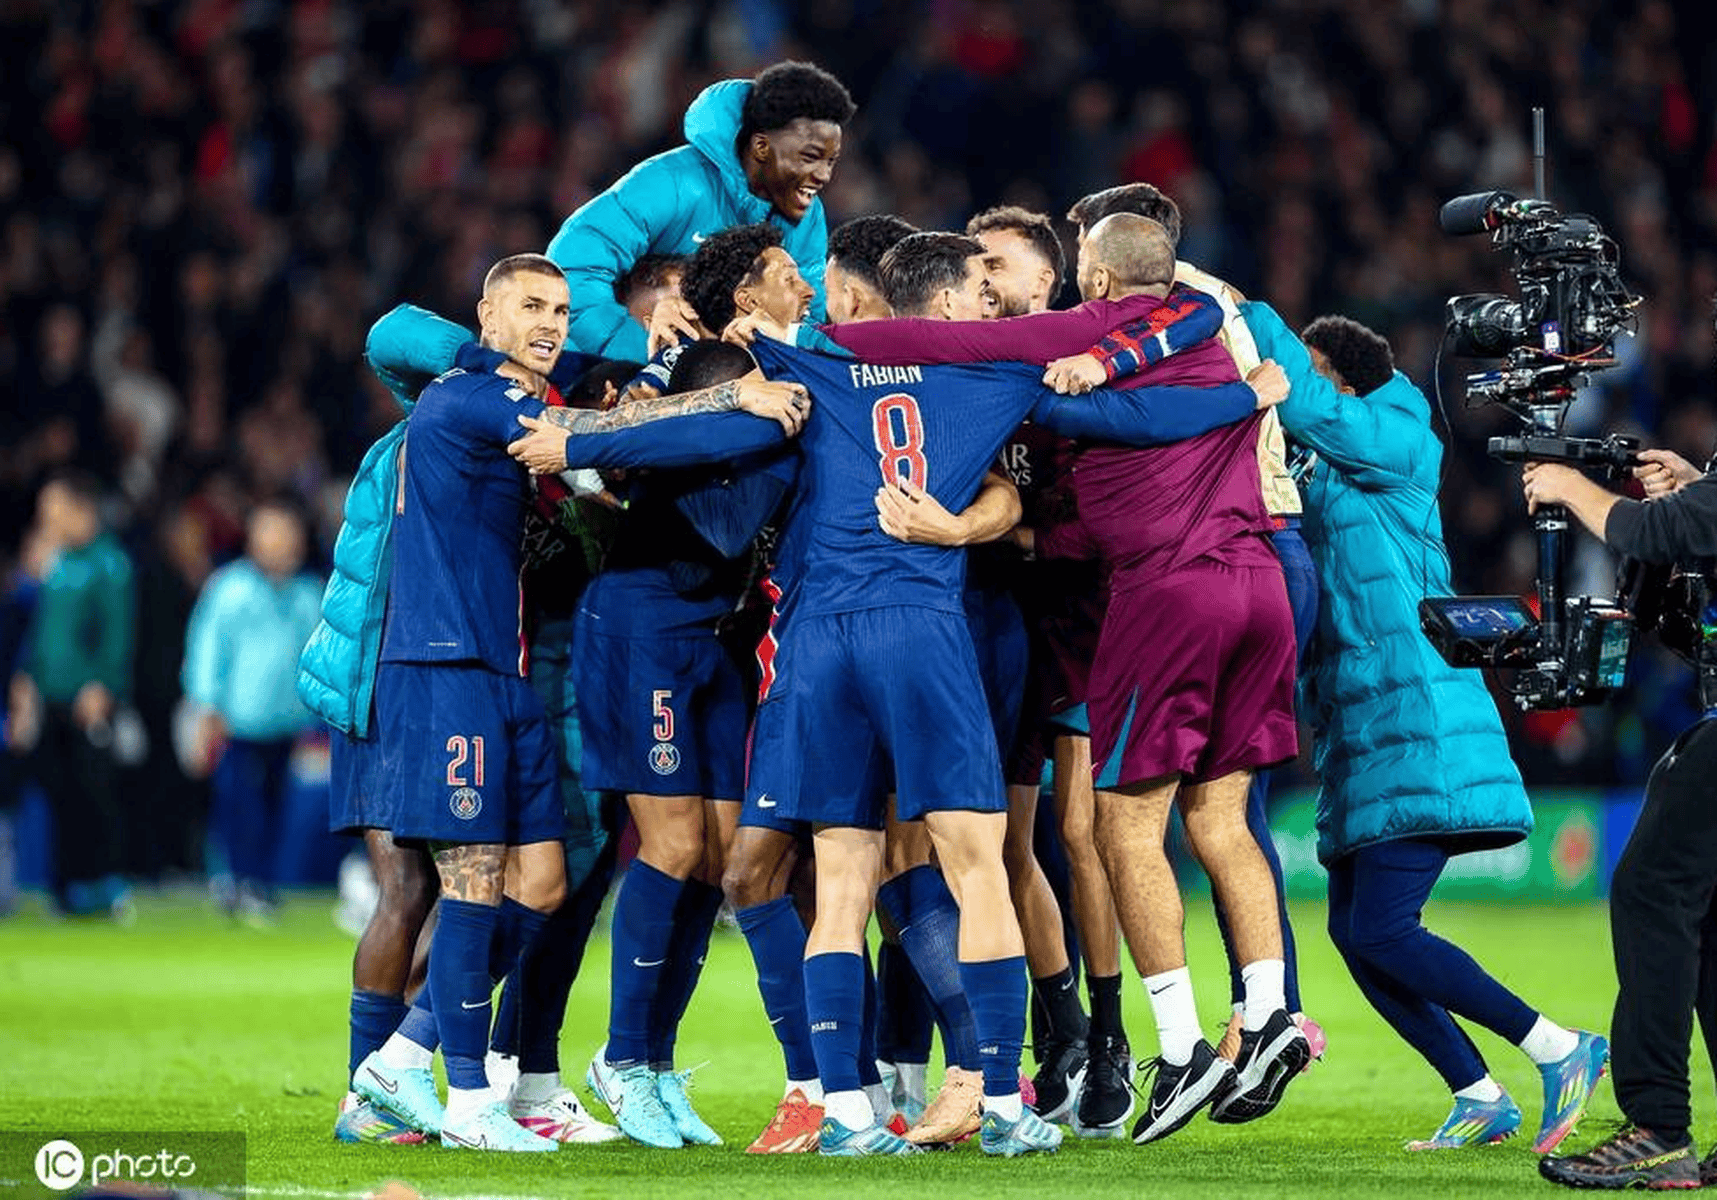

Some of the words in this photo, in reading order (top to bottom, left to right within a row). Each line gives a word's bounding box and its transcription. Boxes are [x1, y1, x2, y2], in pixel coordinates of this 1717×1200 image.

[849, 363, 923, 388] FABIAN
[872, 393, 928, 492] 8
[653, 690, 673, 742] 5
[446, 735, 484, 787] 21
